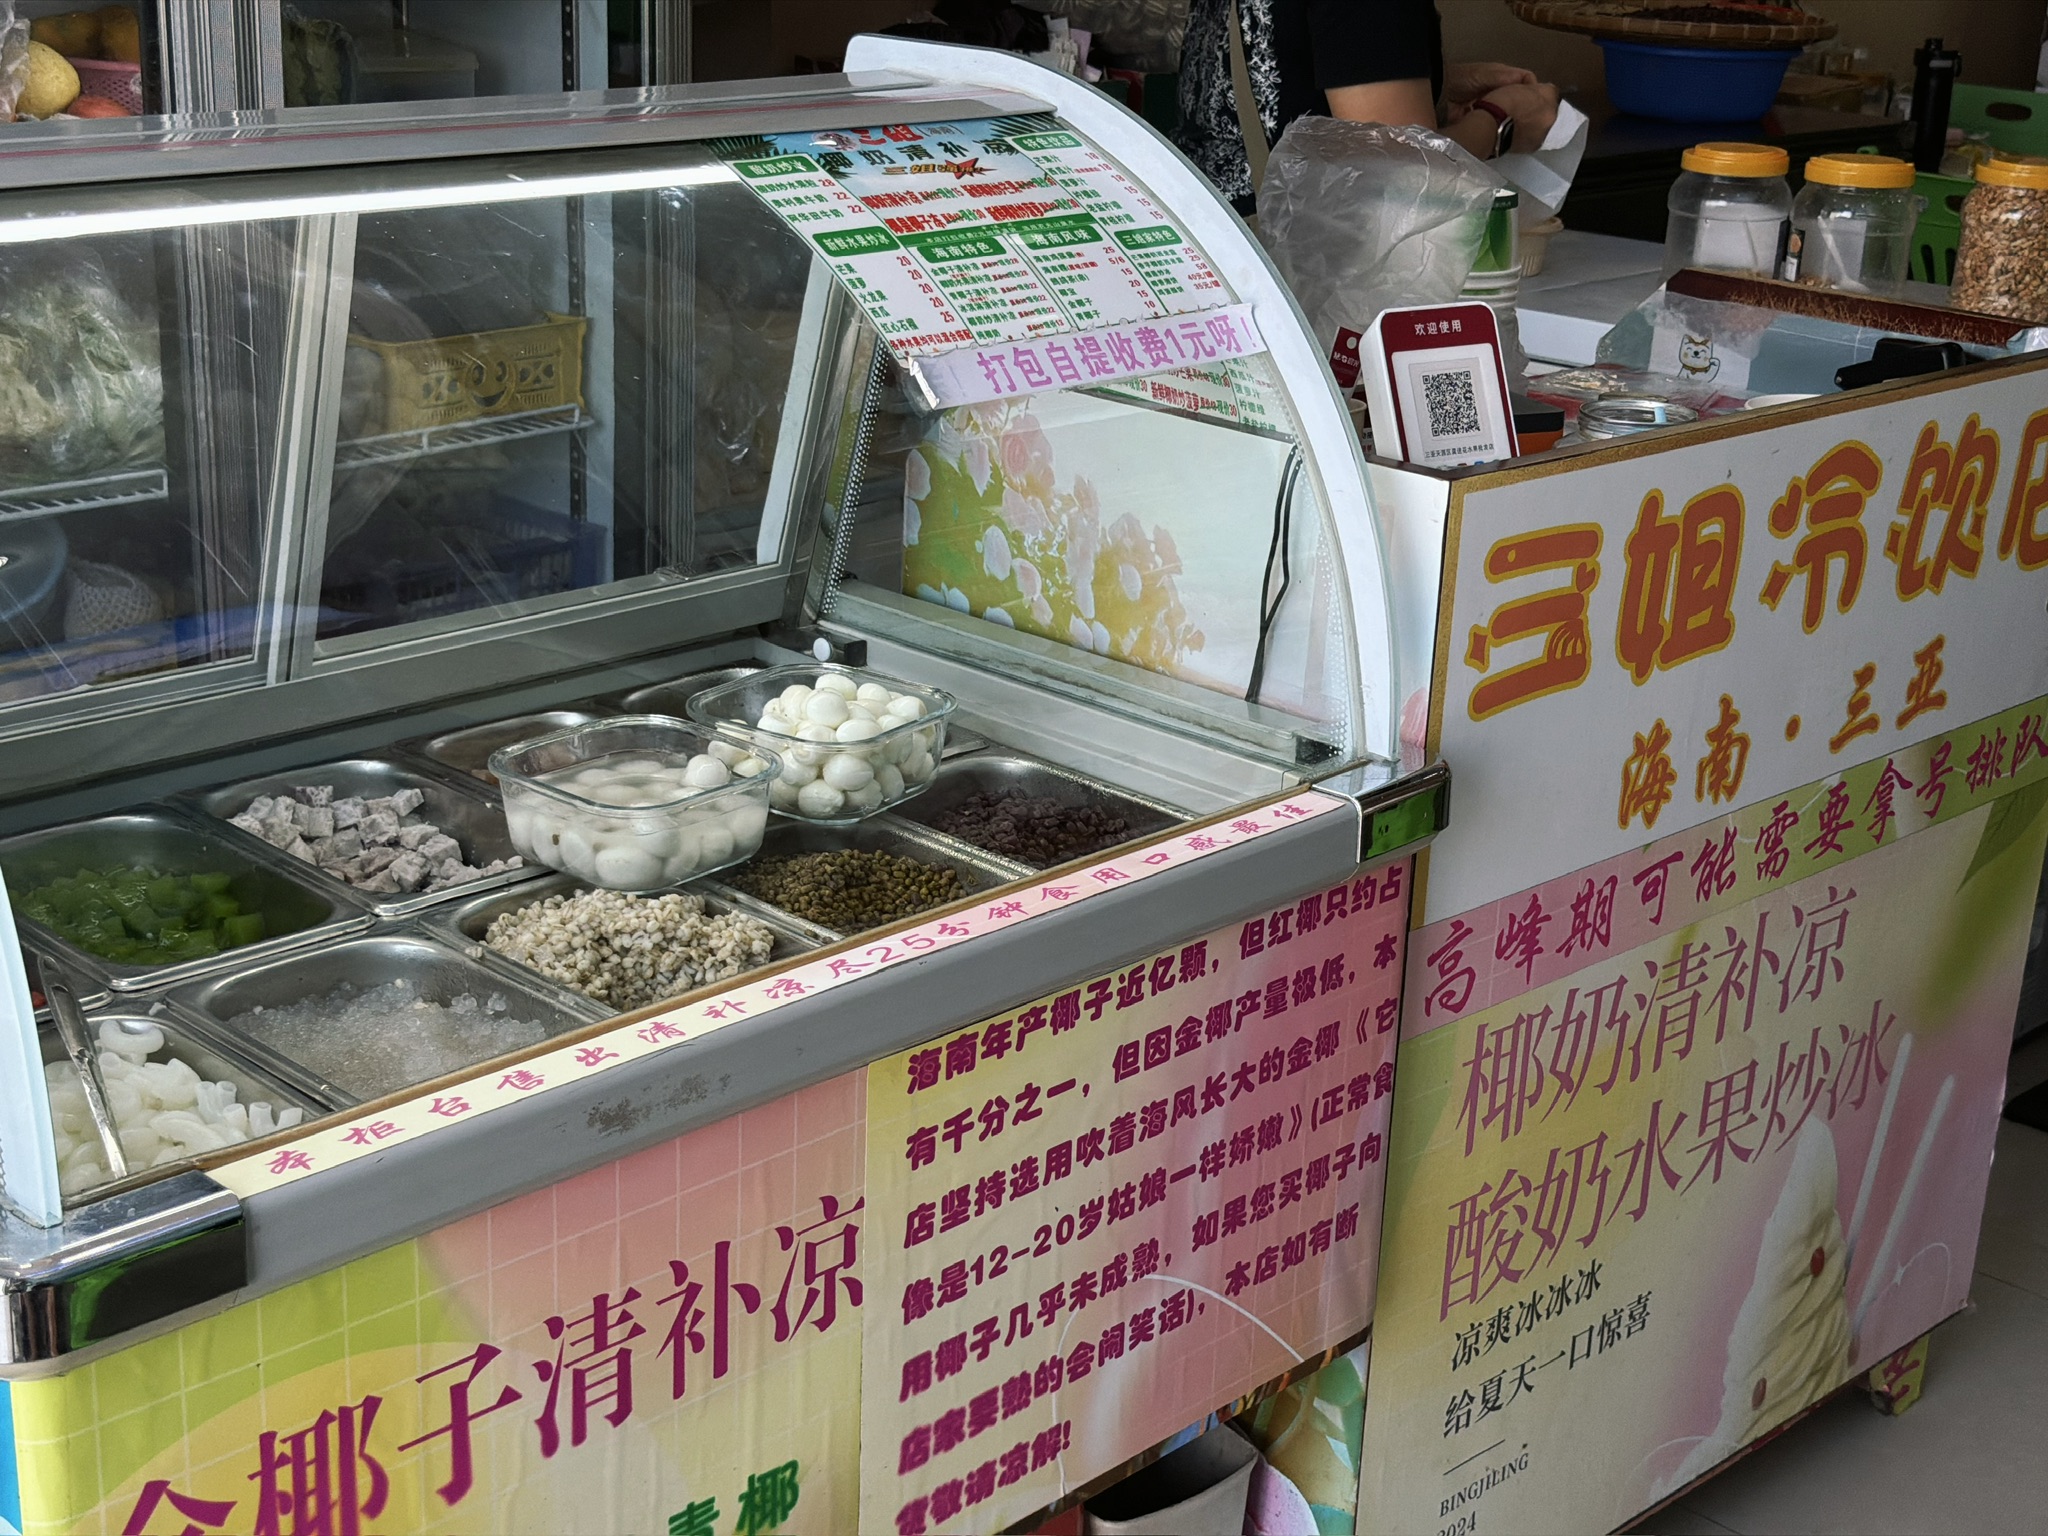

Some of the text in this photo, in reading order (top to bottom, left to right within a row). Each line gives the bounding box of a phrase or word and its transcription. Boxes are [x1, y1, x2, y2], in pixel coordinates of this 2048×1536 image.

[1022, 136, 1077, 149] 特色饮品
[823, 138, 1012, 168] 椰奶清补凉
[1085, 152, 1100, 160] 18
[748, 160, 807, 175] 酸奶炒冰
[1098, 163, 1113, 171] 18
[754, 179, 835, 194] 酸奶炒水果粒 28
[1111, 174, 1125, 182] 18
[1124, 186, 1138, 194] 15
[771, 192, 850, 208] 奥利奥牛奶 22
[1137, 197, 1151, 206] 15
[786, 205, 865, 223] 阿华田牛奶 22
[1150, 210, 1164, 220] 15
[823, 232, 890, 251] 新鲜水果炒冰
[1031, 229, 1092, 246] 海南风味
[1122, 230, 1175, 245] 三姐家特色
[931, 241, 993, 259] 海南特色
[1182, 247, 1195, 255] 25
[1189, 254, 1201, 262] 25
[835, 256, 911, 275] 芒果 20
[1121, 268, 1133, 276] 15
[846, 269, 922, 289] 菠萝 20
[859, 283, 933, 304] 火龙果 20
[1068, 290, 1149, 309] 金椰子 15
[869, 297, 944, 319] 西瓜 20
[1075, 300, 1156, 321] 青椰子 10
[880, 311, 955, 334] 红心石榴 25
[1414, 320, 1462, 336] 欢迎使用
[890, 329, 973, 350] 各种水果均可以混合搭配
[1424, 714, 2048, 1017] 高峰期可能需要拿号排队
[1456, 885, 1857, 1158] 椰奶清补凉
[1440, 999, 1896, 1323] 酸奶水果炒冰
[1451, 1257, 1603, 1372] 凉爽冰冰冰
[1443, 1290, 1652, 1439] 给夏天一口惊喜
[1439, 1452, 1529, 1518] BINGJILING
